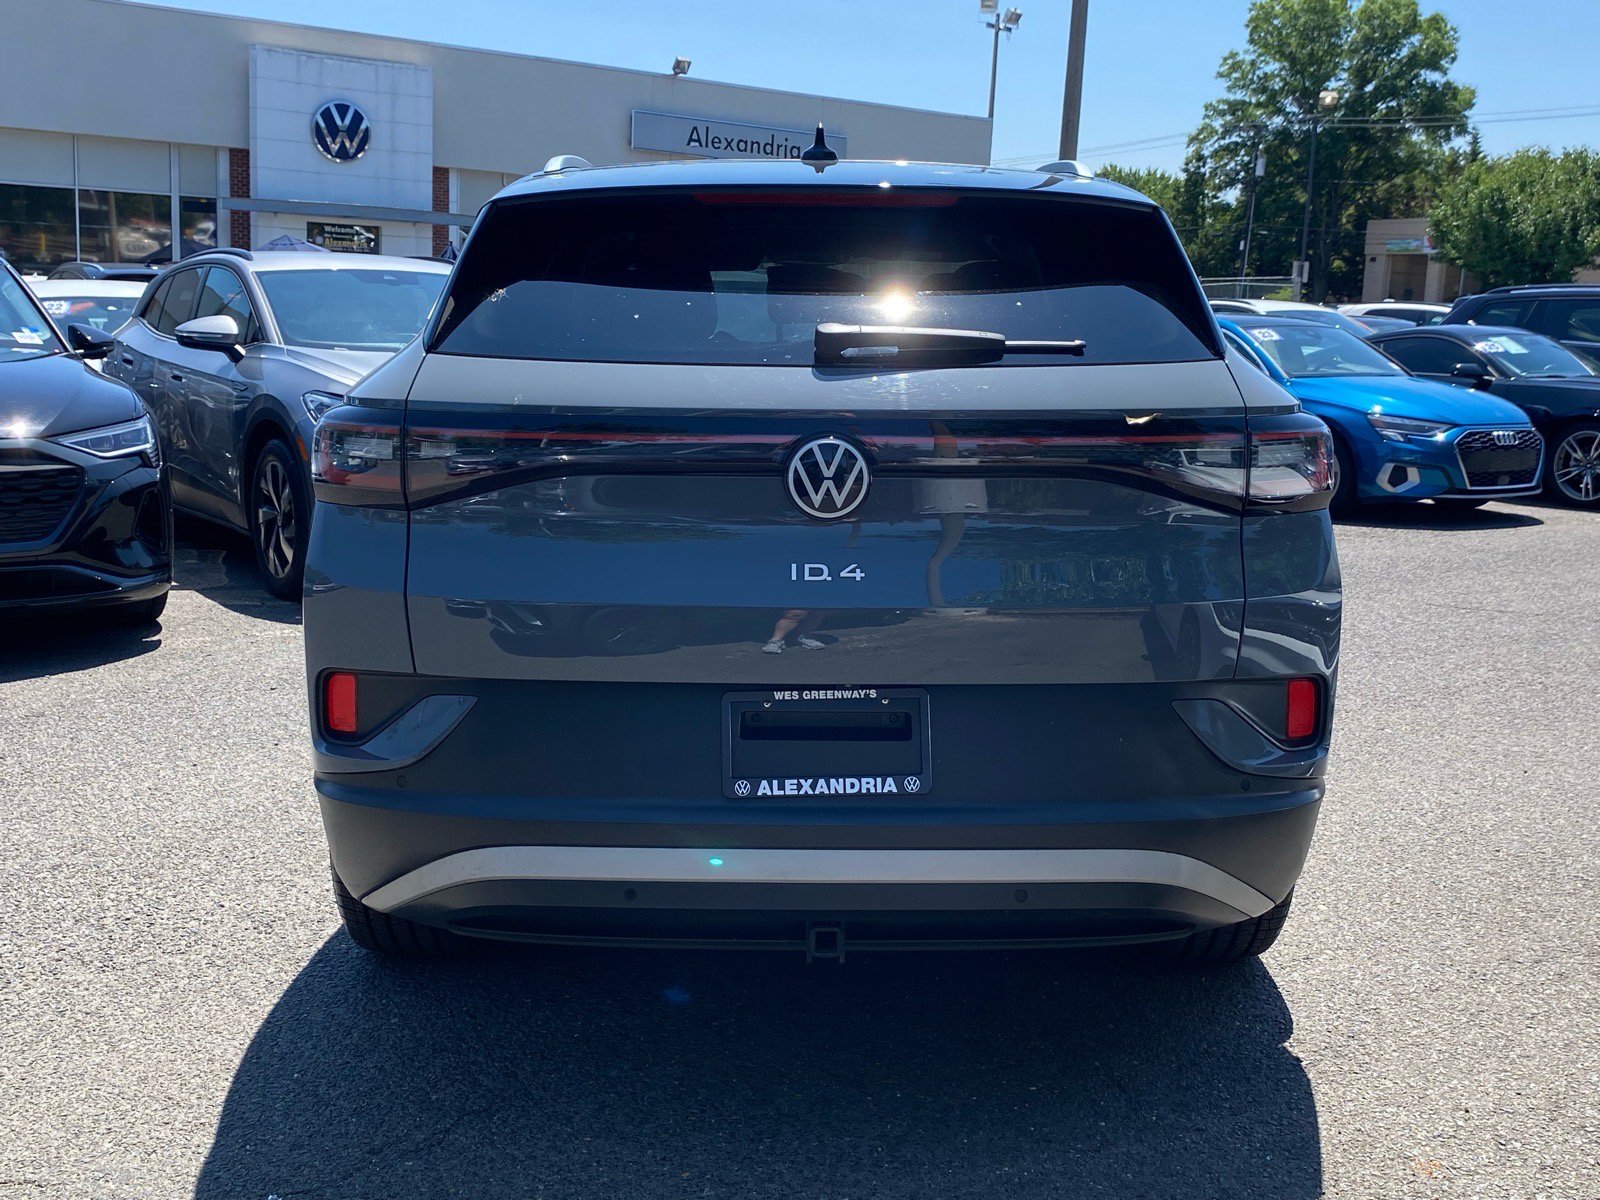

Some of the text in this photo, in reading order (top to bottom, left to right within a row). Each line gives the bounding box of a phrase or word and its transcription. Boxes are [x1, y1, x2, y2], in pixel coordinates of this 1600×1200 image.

[686, 126, 801, 159] Alexandria
[324, 225, 357, 234] Welcome
[774, 689, 877, 700] WES GREENWAY'S
[757, 777, 898, 796] ALEXANDRIA
